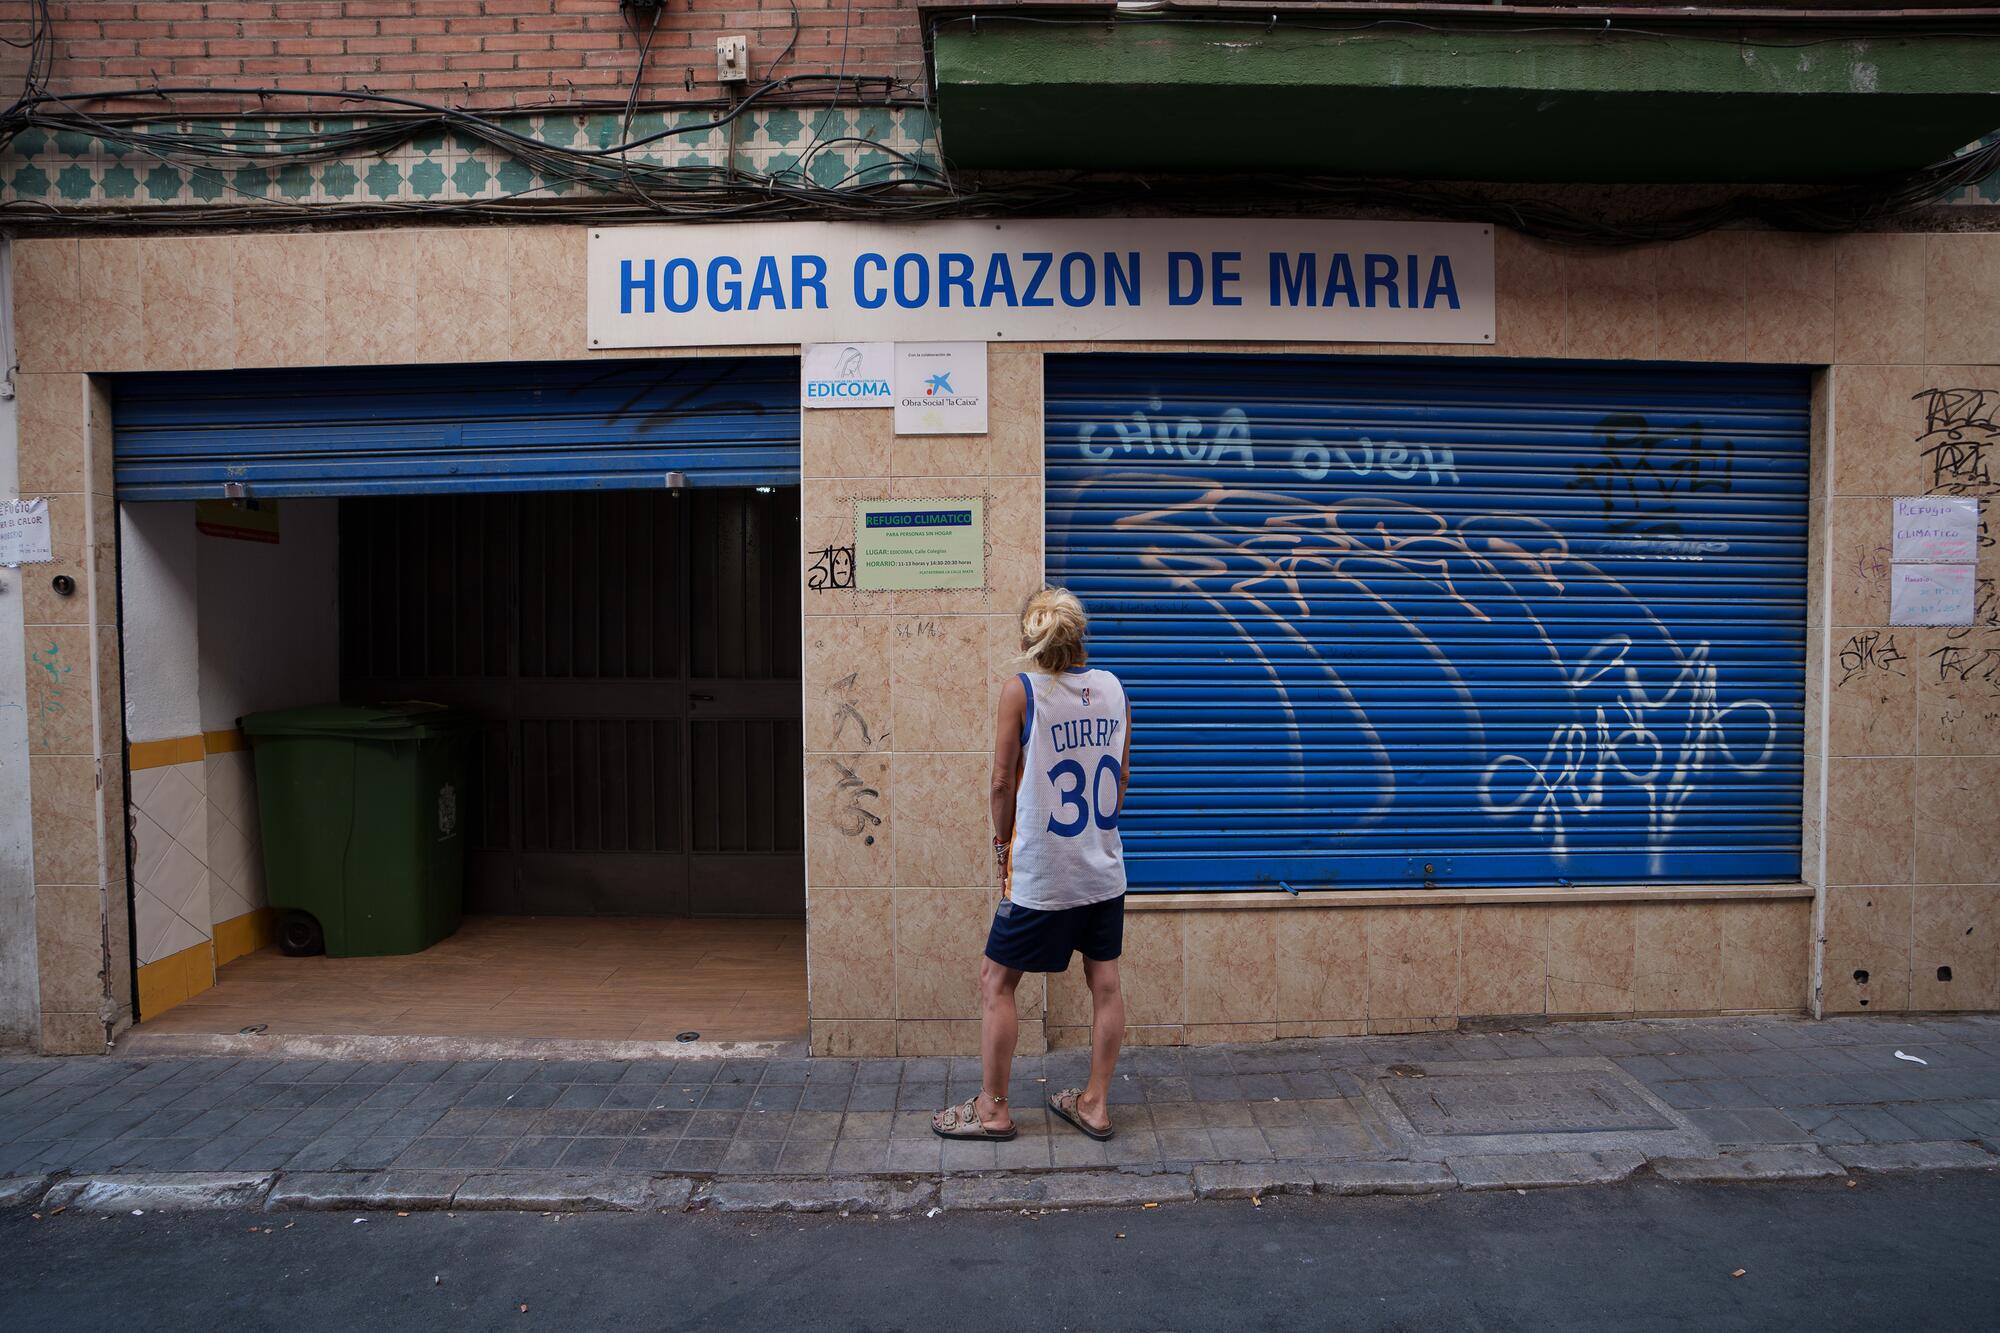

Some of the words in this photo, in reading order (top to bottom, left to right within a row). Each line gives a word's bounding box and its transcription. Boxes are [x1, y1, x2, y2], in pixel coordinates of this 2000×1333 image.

[620, 255, 829, 314] HOGAR
[853, 252, 1141, 309] CORAZON
[1168, 252, 1242, 306] DE
[1269, 252, 1461, 310] MARIA
[808, 382, 891, 397] EDICOMA
[901, 399, 922, 408] Obra
[922, 398, 945, 407] Social
[0, 503, 30, 516] EFUGIO
[17, 515, 43, 526] CALOR
[866, 515, 912, 525] REFUGIO
[914, 513, 972, 524] CLIMATICO
[1050, 718, 1119, 753] CURRY
[1046, 754, 1121, 837] 30
